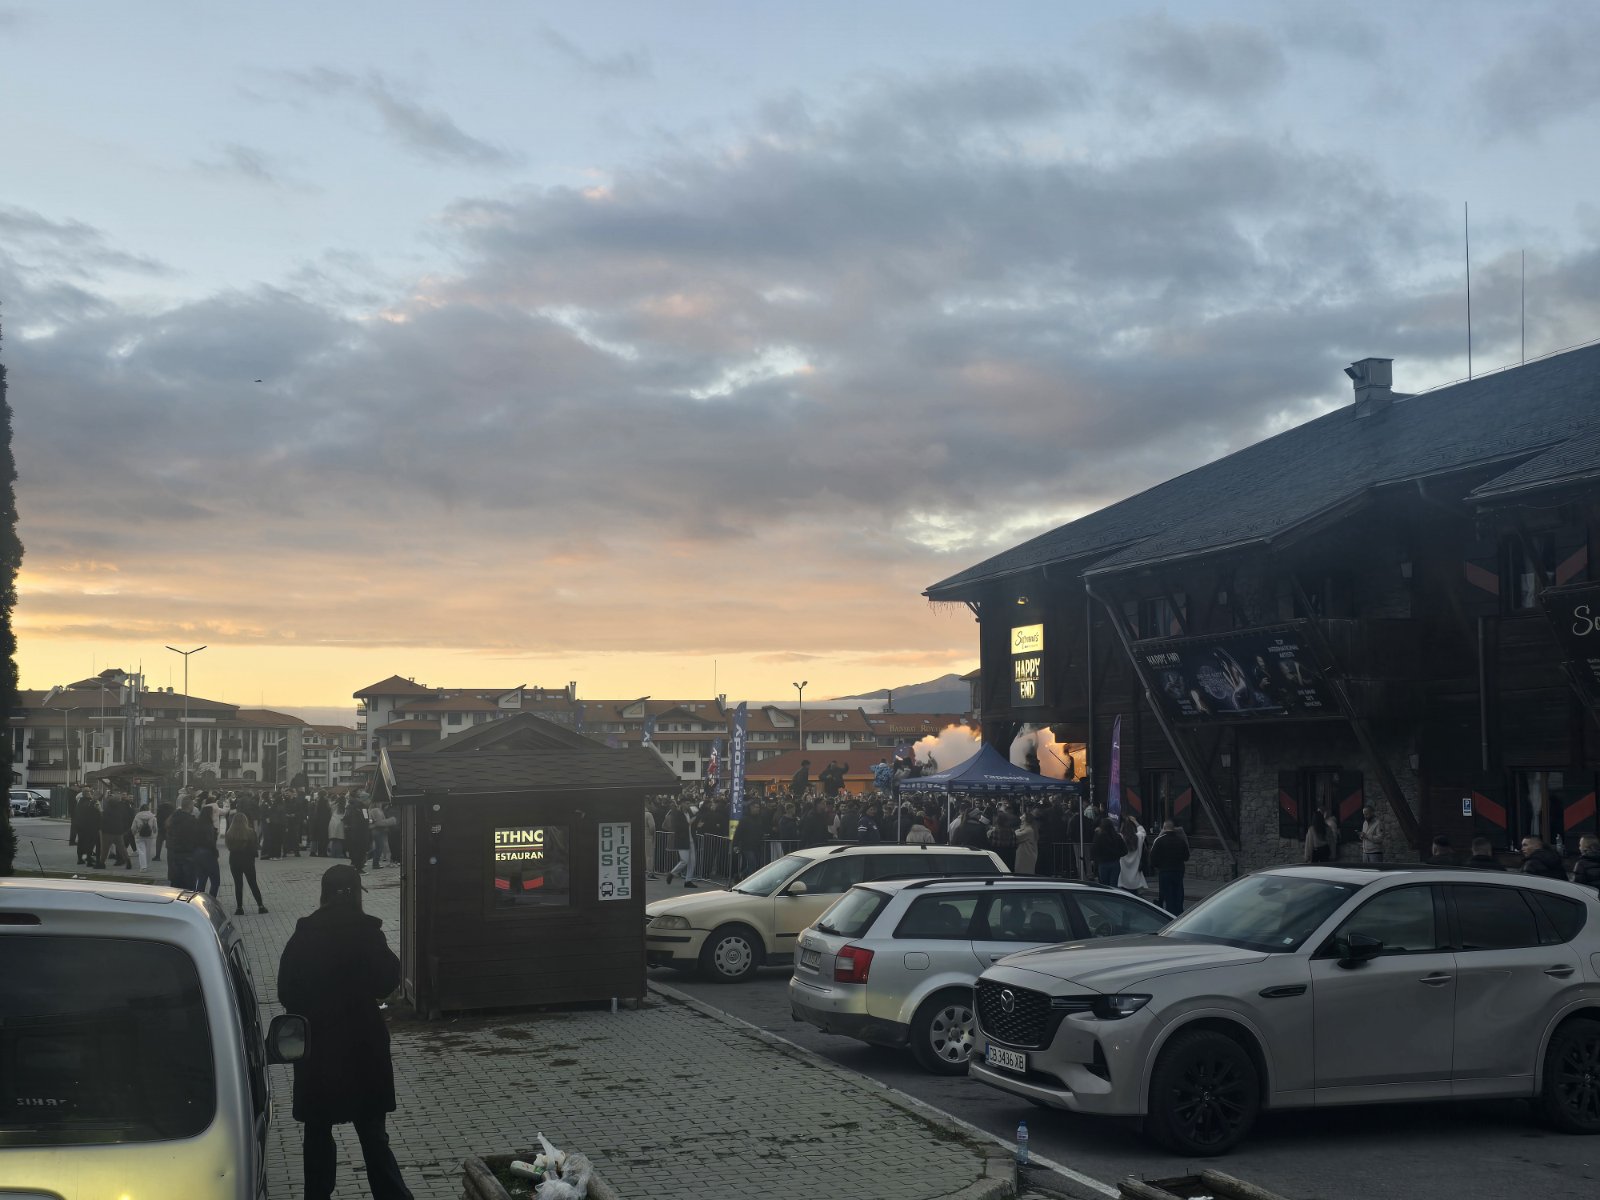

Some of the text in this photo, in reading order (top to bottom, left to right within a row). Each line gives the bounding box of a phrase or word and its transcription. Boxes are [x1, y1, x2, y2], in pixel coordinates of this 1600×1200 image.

[1014, 657, 1041, 679] HAPPY
[1020, 681, 1035, 699] END
[732, 724, 743, 814] rapsody
[495, 851, 544, 861] ESTAURAN
[601, 826, 613, 866] BUS
[616, 825, 630, 897] TICKETS
[997, 1050, 1014, 1066] 3436
